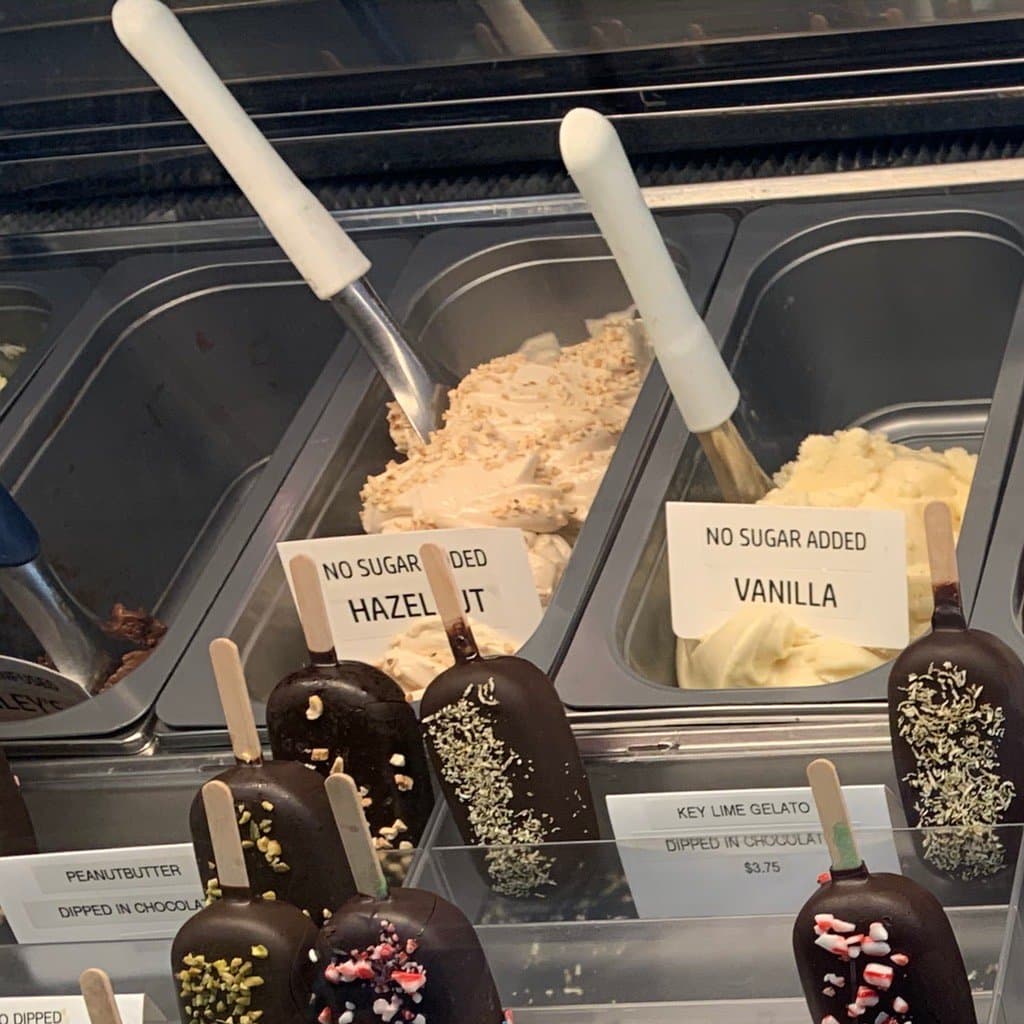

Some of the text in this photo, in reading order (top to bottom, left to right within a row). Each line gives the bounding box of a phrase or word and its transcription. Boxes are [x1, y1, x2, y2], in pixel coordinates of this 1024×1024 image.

[706, 527, 867, 551] NO SUGAR ADDED
[322, 548, 488, 580] NO SUGAR DED
[734, 577, 838, 609] VANILLA
[348, 588, 485, 623] HAZELUT
[677, 801, 810, 820] KEY LIME GELATO
[665, 831, 822, 853] DIPPED IN CHOCOLAT
[65, 864, 182, 883] PEANUTBUTTER
[744, 861, 780, 875] $3.75
[58, 899, 205, 919] DIPPED IN CHOCOLA
